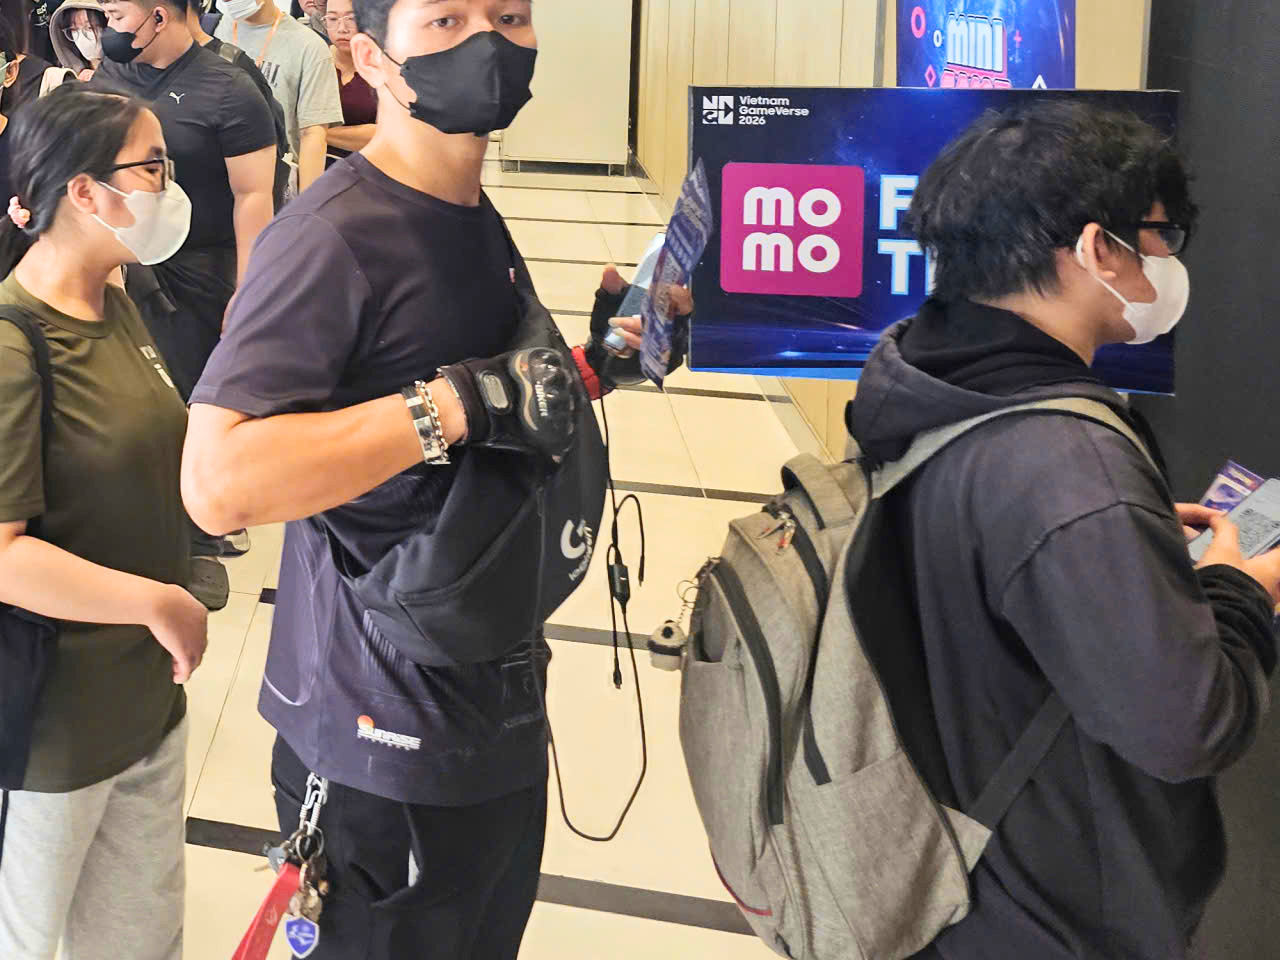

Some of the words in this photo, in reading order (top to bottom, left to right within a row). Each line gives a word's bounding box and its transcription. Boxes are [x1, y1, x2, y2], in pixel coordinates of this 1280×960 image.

[738, 95, 790, 106] Vietnam
[738, 106, 810, 116] GameVerse
[738, 116, 766, 125] 2026
[743, 186, 842, 227] mo
[742, 231, 841, 273] mo
